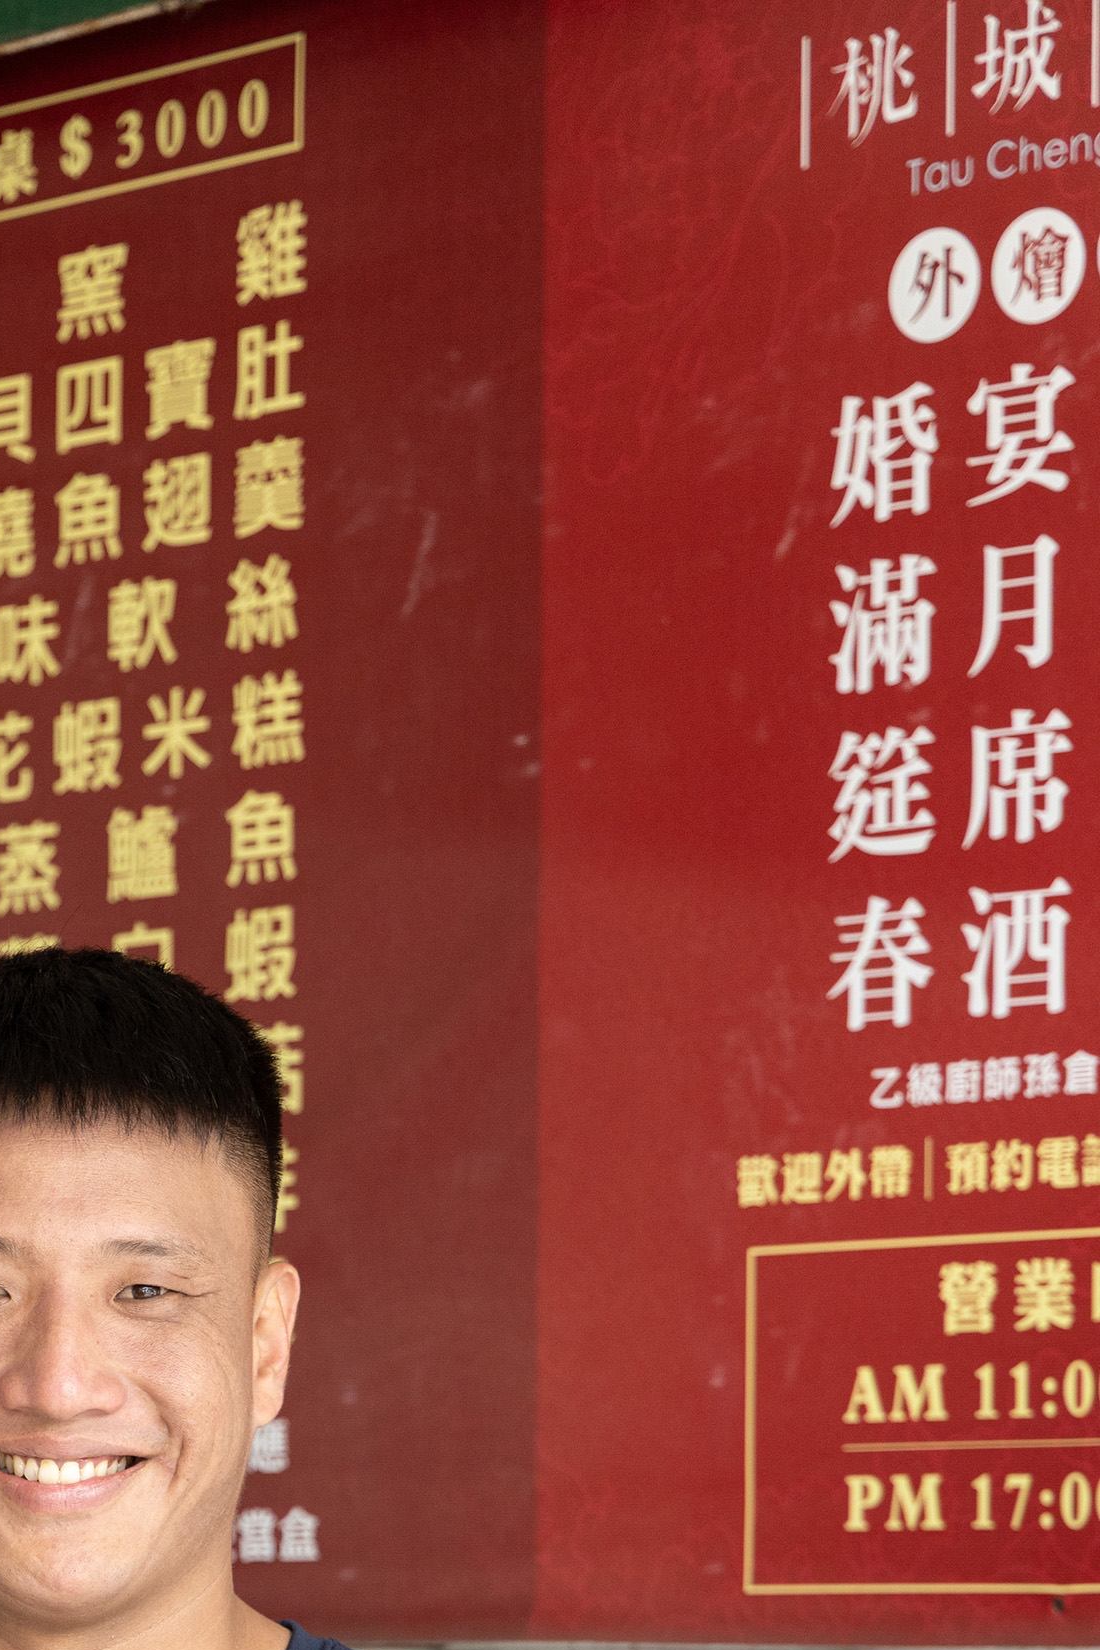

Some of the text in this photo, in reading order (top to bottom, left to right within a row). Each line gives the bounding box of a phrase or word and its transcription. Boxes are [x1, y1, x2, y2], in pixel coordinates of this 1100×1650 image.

[905, 132, 1100, 196] Tau Chen
[906, 226, 1071, 325] 外燴
[830, 363, 1076, 528] 婚宴
[828, 533, 1062, 694] 滿月
[828, 708, 1073, 864] 筵席
[826, 877, 1072, 1032] 春酒
[736, 1144, 913, 1208] 歡迎外帶
[938, 1257, 1100, 1336] 營業
[842, 1359, 1100, 1424] AM 11:0
[843, 1471, 1100, 1533] PM 17:0
